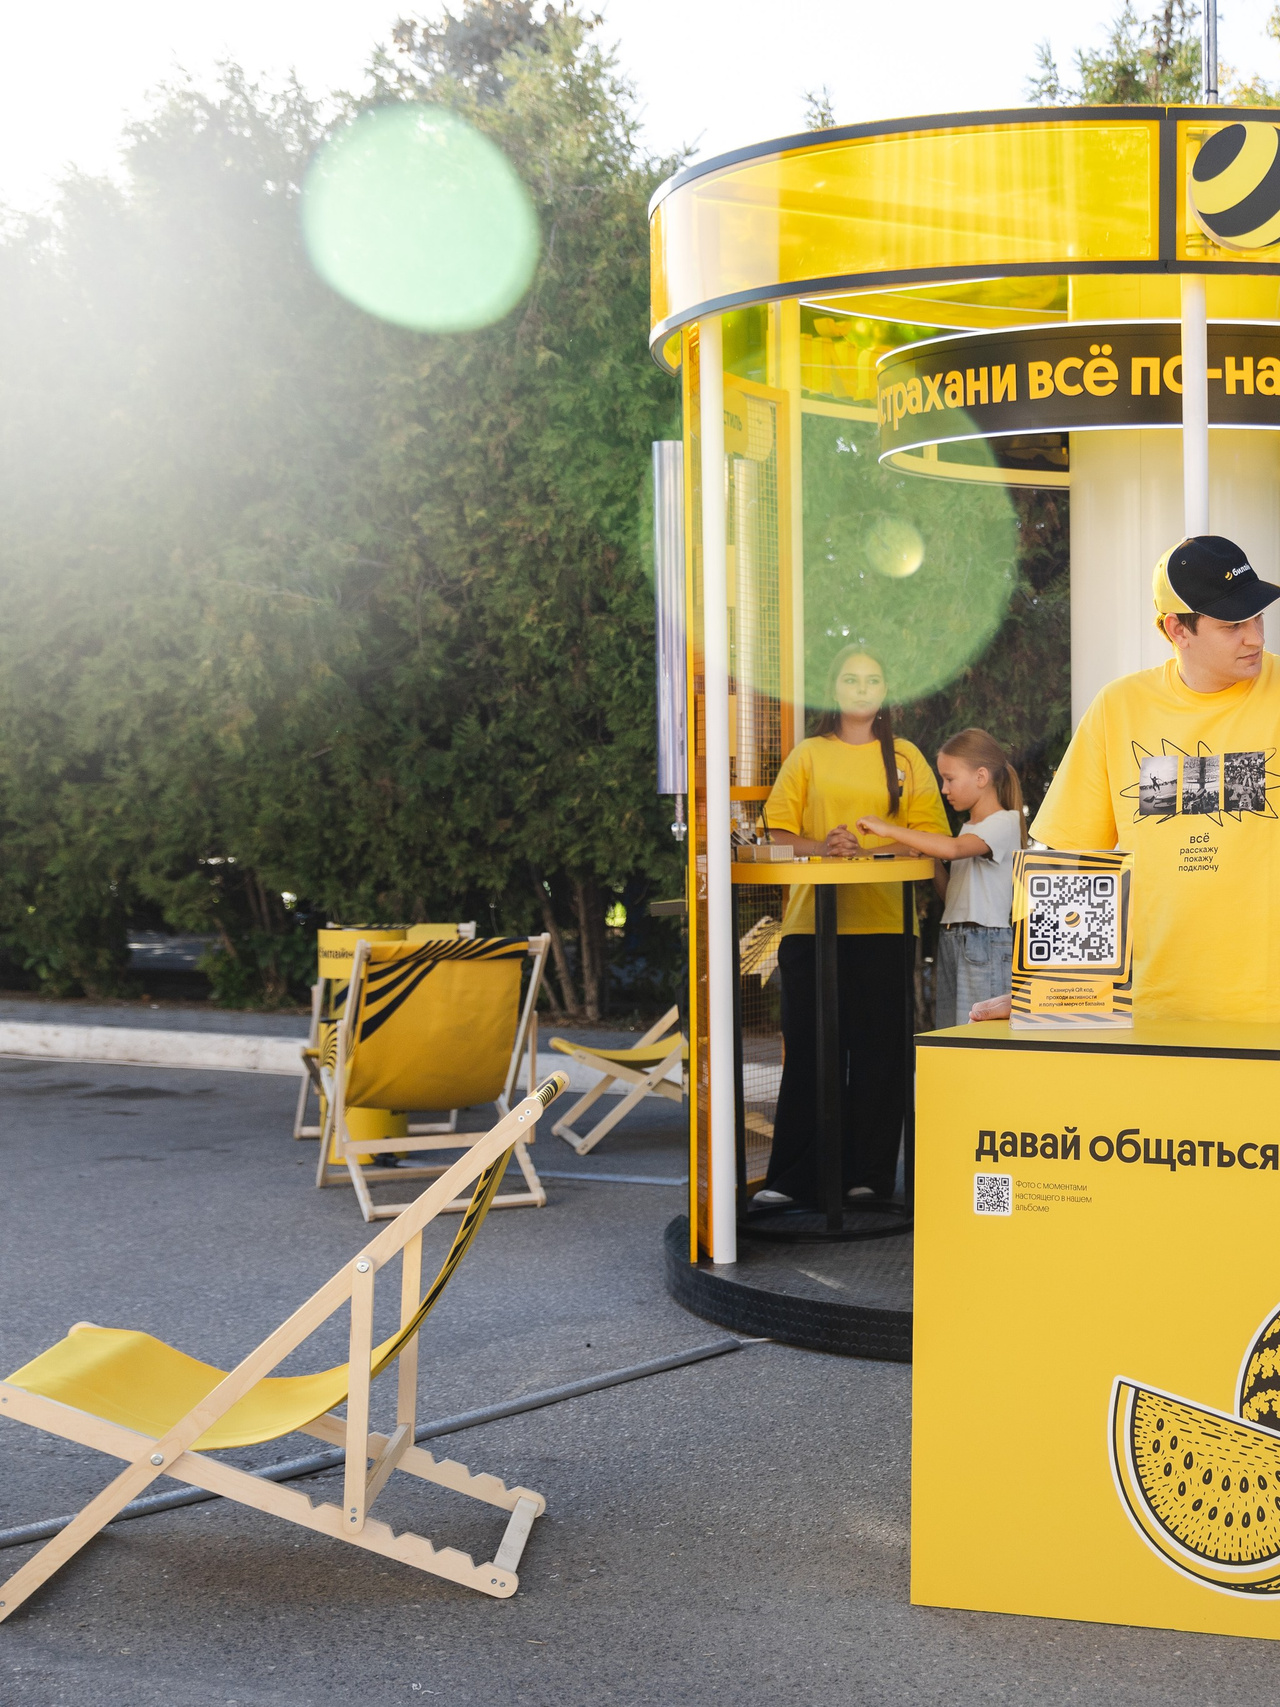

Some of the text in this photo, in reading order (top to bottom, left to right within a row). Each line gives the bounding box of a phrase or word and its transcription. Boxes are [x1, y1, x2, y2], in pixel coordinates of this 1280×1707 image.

[878, 363, 1017, 431] страхани
[1028, 344, 1119, 400] всё
[1189, 832, 1210, 844] всё
[1179, 846, 1219, 855] расскажу
[1183, 855, 1214, 863] покажу
[1178, 864, 1219, 872] подключу
[975, 1125, 1280, 1172] давай общаться
[1015, 1179, 1037, 1189] Фото
[1042, 1182, 1088, 1192] моментами
[1014, 1192, 1061, 1202] настоящего
[1066, 1195, 1093, 1204] нашем
[1014, 1202, 1050, 1213] альбоме
